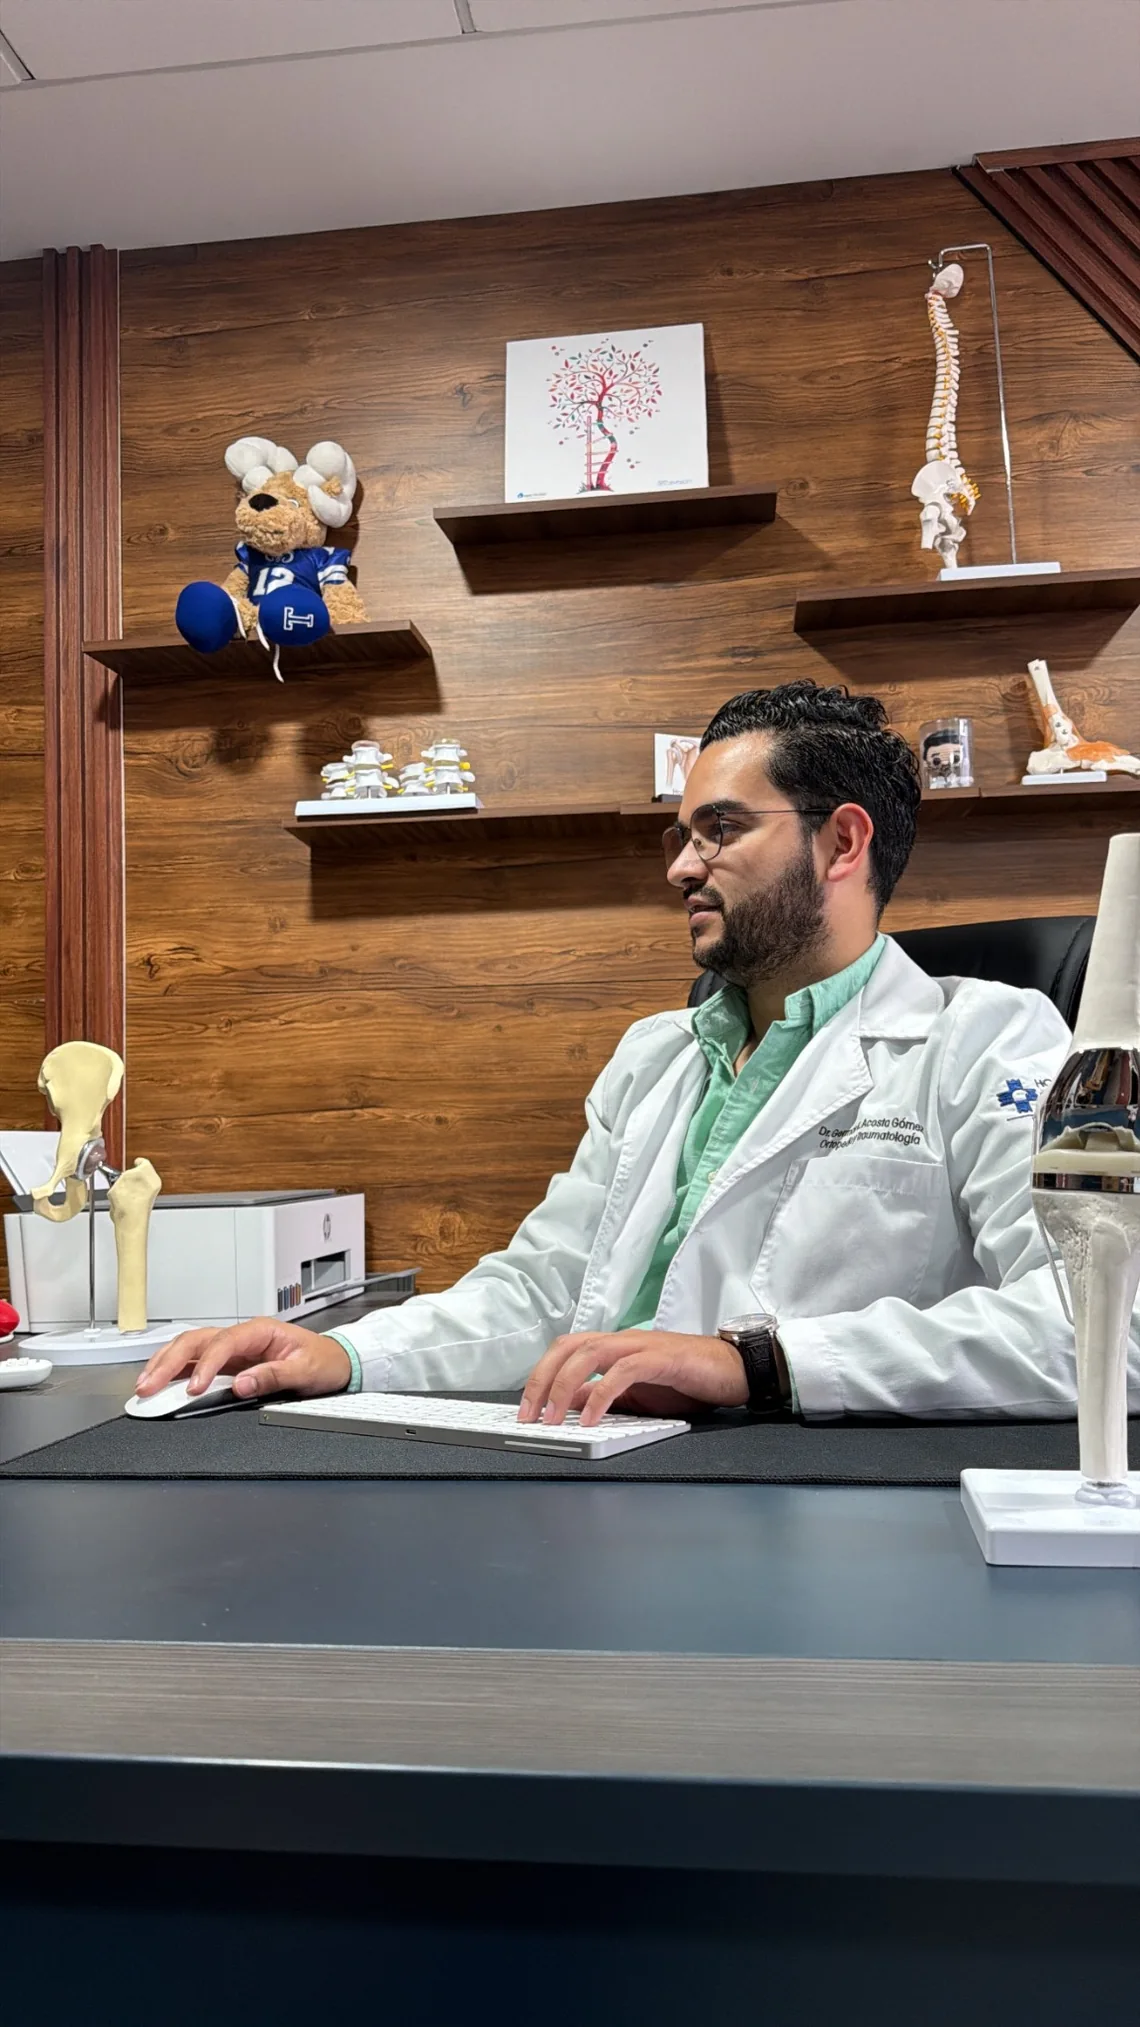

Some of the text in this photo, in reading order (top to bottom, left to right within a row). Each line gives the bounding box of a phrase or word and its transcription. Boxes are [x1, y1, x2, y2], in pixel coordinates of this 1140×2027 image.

[253, 567, 295, 596] 12
[818, 1126, 830, 1137] Dr.
[861, 1118, 890, 1128] Acosta
[891, 1116, 924, 1132] Gómez
